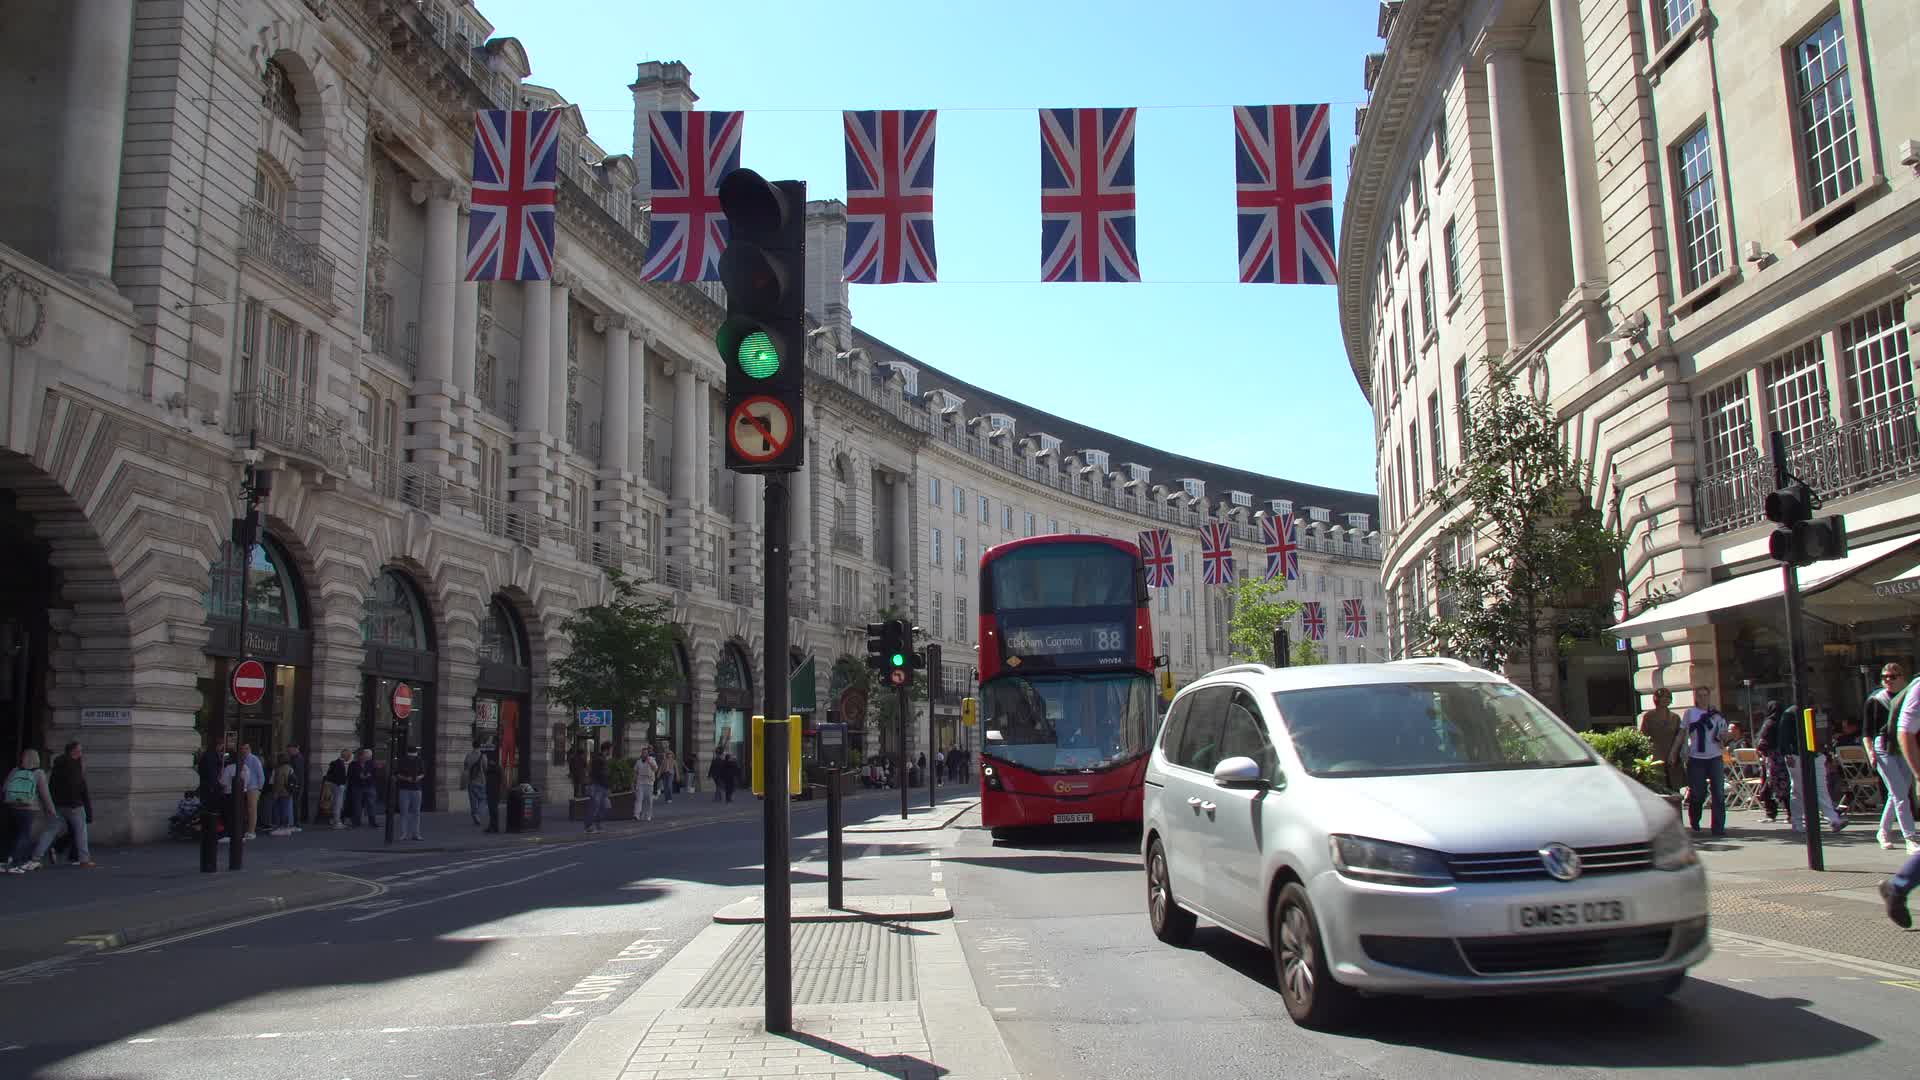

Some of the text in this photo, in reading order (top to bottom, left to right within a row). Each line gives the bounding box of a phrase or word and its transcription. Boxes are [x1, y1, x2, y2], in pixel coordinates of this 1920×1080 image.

[1876, 582, 1911, 597] CAKES
[1007, 631, 1121, 650] Clapham Common 88
